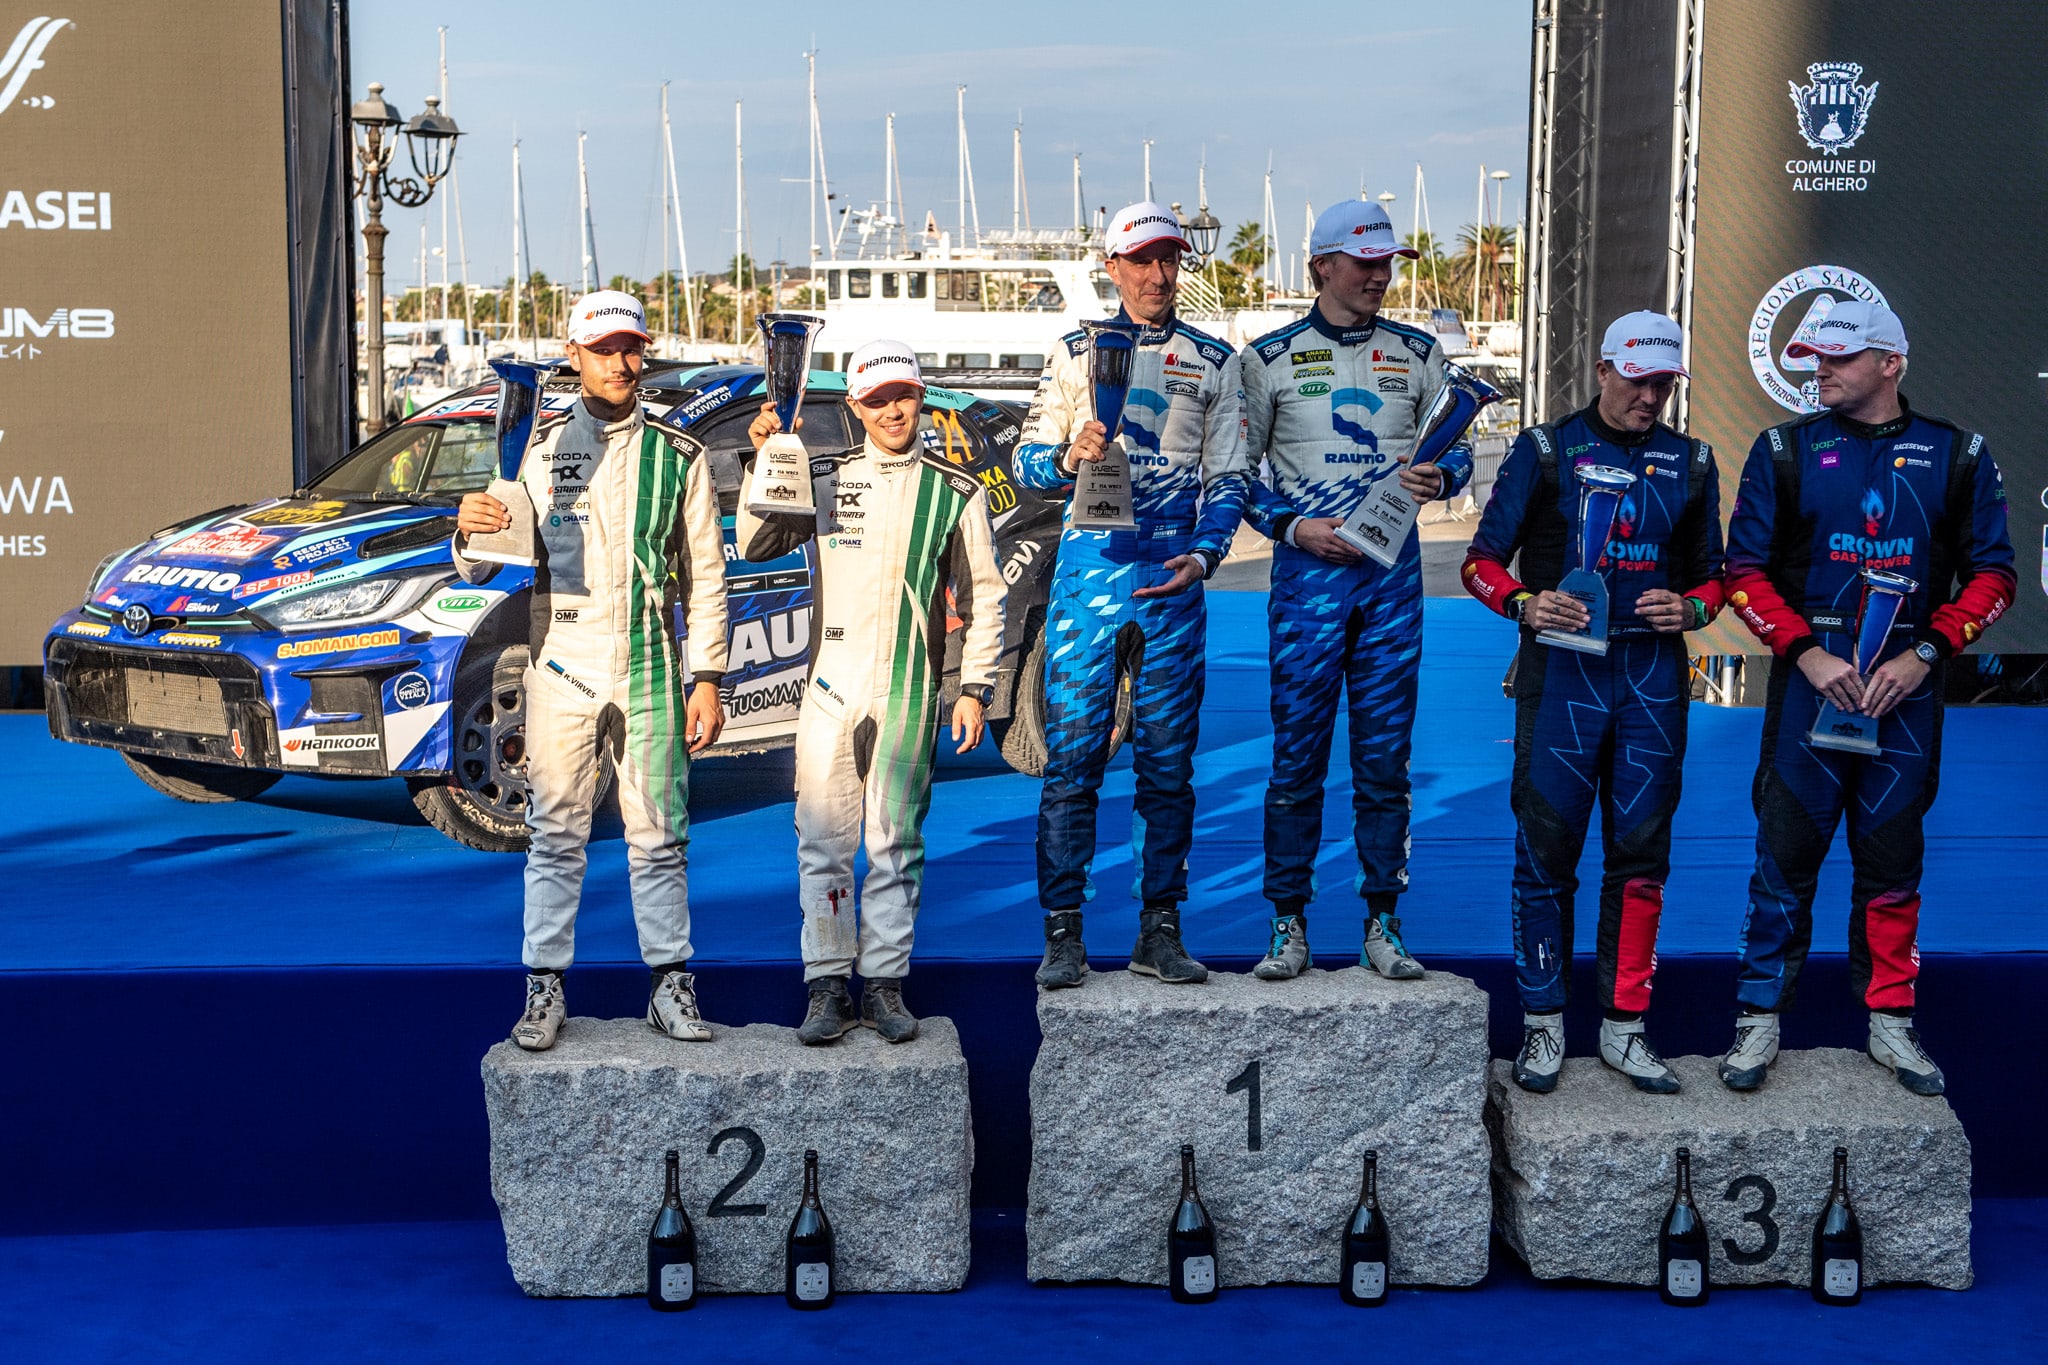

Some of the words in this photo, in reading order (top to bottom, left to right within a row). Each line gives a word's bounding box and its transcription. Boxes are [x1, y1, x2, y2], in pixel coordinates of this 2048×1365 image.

[1785, 159, 1856, 174] COMUNE
[1859, 159, 1876, 174] DI
[1793, 177, 1868, 191] ALGHERO
[1753, 275, 1807, 359] REGIONE
[1264, 343, 1286, 356] OMP
[1408, 338, 1427, 353] OMP
[1202, 347, 1222, 361] OMP
[1763, 371, 1802, 407] PROTEZIONE
[688, 396, 721, 419] KAIVIN
[719, 390, 733, 402] OY
[932, 407, 974, 464] 21
[672, 438, 694, 454] OMP
[1566, 444, 1588, 457] gap
[1811, 440, 1836, 452] gap
[769, 453, 797, 461] WRC
[1325, 453, 1386, 464] RAUTIO
[812, 464, 832, 472] OMP
[1091, 464, 1121, 473] WRC
[951, 478, 972, 493] OMP
[293, 537, 346, 557] RESPECT
[297, 541, 351, 563] PROJECT
[1829, 533, 1913, 559] CROWN
[1830, 550, 1858, 564] GAS
[1866, 555, 1911, 568] POWER
[122, 564, 242, 592] RAUTIO
[245, 580, 270, 595] SP
[276, 572, 311, 587] 1003
[440, 598, 487, 609] VIITA
[555, 611, 579, 621] OMP
[1812, 616, 1842, 626] sparco
[825, 629, 844, 639] OMP
[278, 630, 400, 659] SJOMAN.COM
[1226, 1061, 1261, 1152] 1
[706, 1126, 767, 1218] 2
[1722, 1174, 1780, 1266] 3
